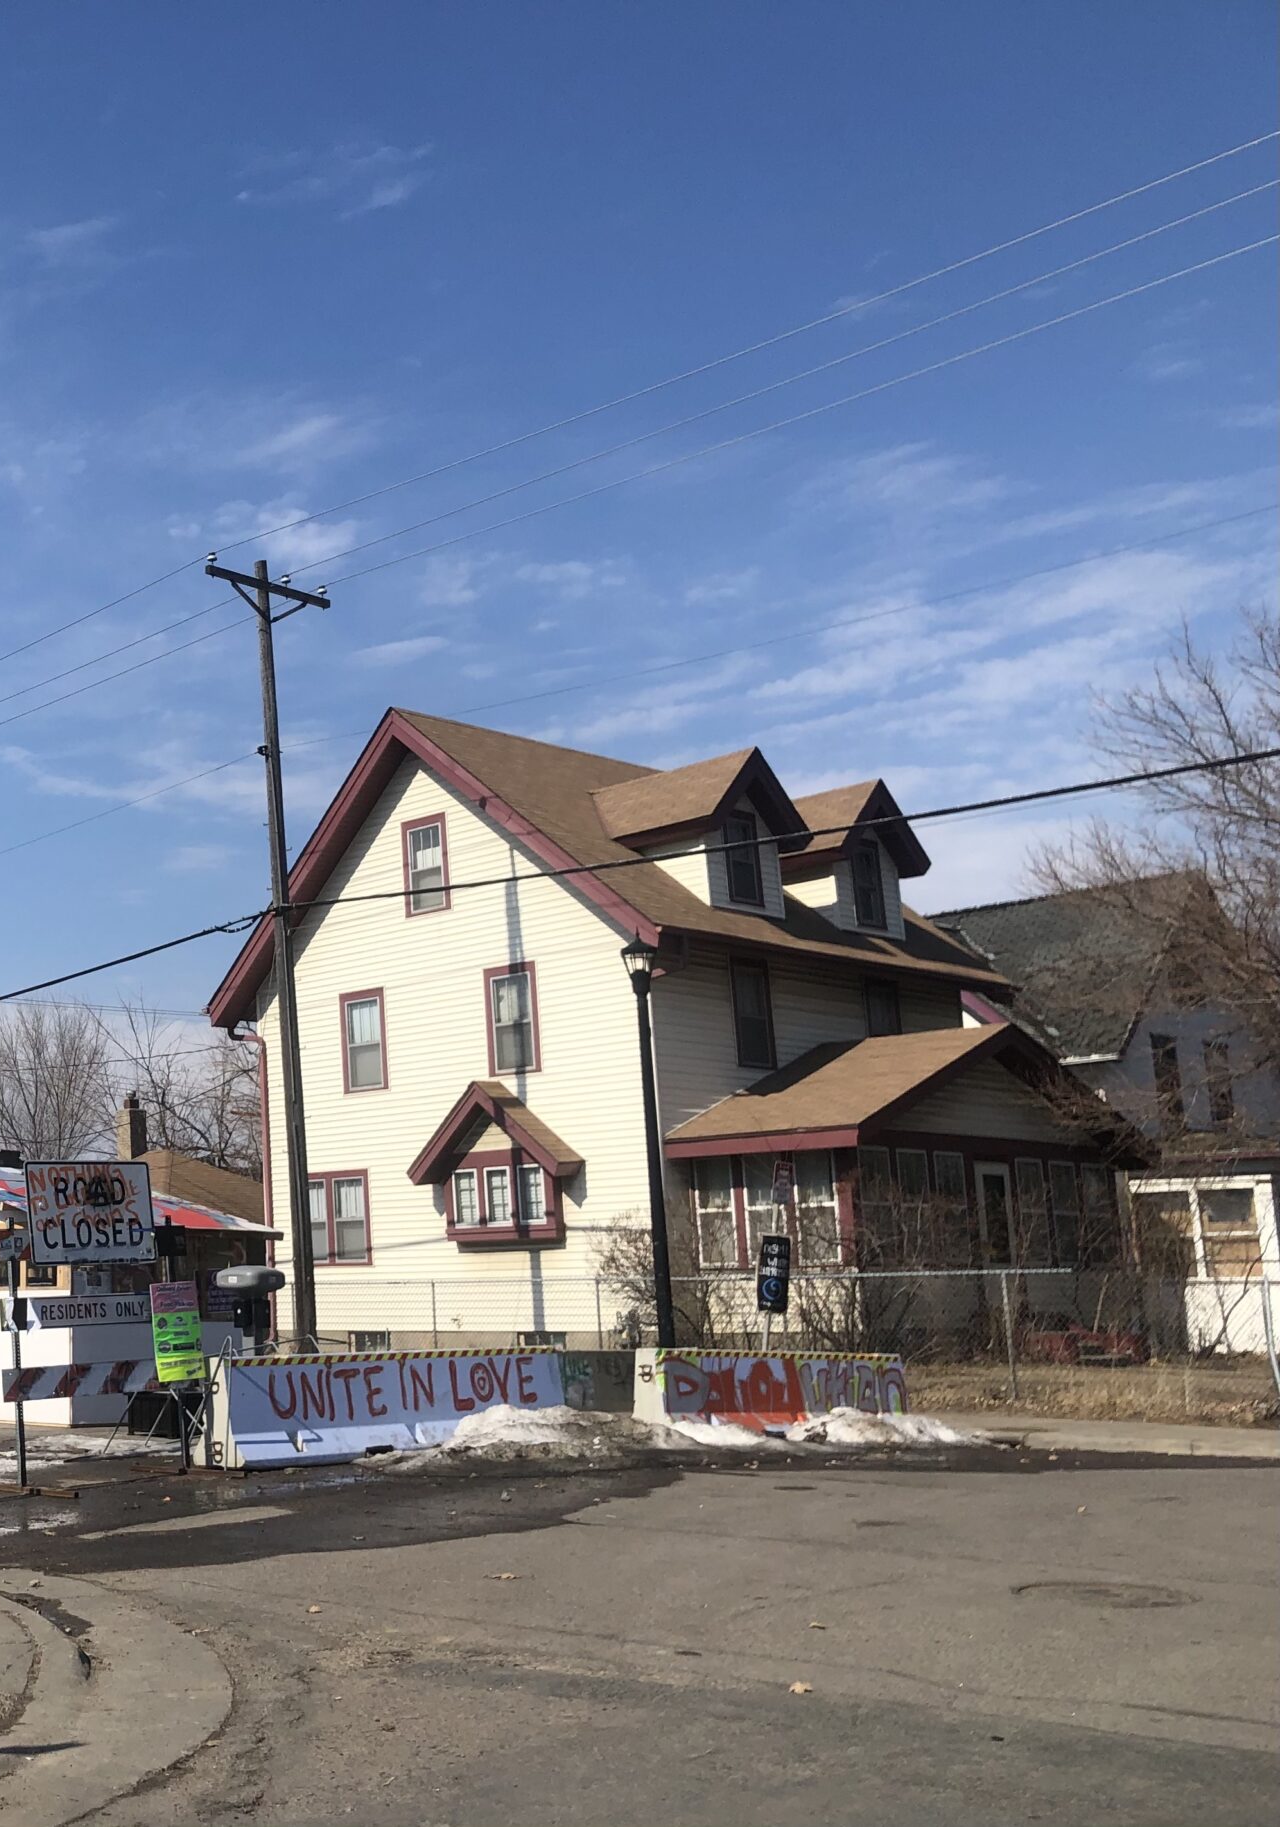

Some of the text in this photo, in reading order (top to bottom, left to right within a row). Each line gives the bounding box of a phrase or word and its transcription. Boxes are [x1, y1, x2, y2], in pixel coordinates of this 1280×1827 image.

[53, 1176, 126, 1206] ROAD
[43, 1217, 144, 1250] CLOSED
[41, 1301, 145, 1320] RESIDENTS ONLY
[268, 1356, 538, 1422] UNITE IN LOVE
